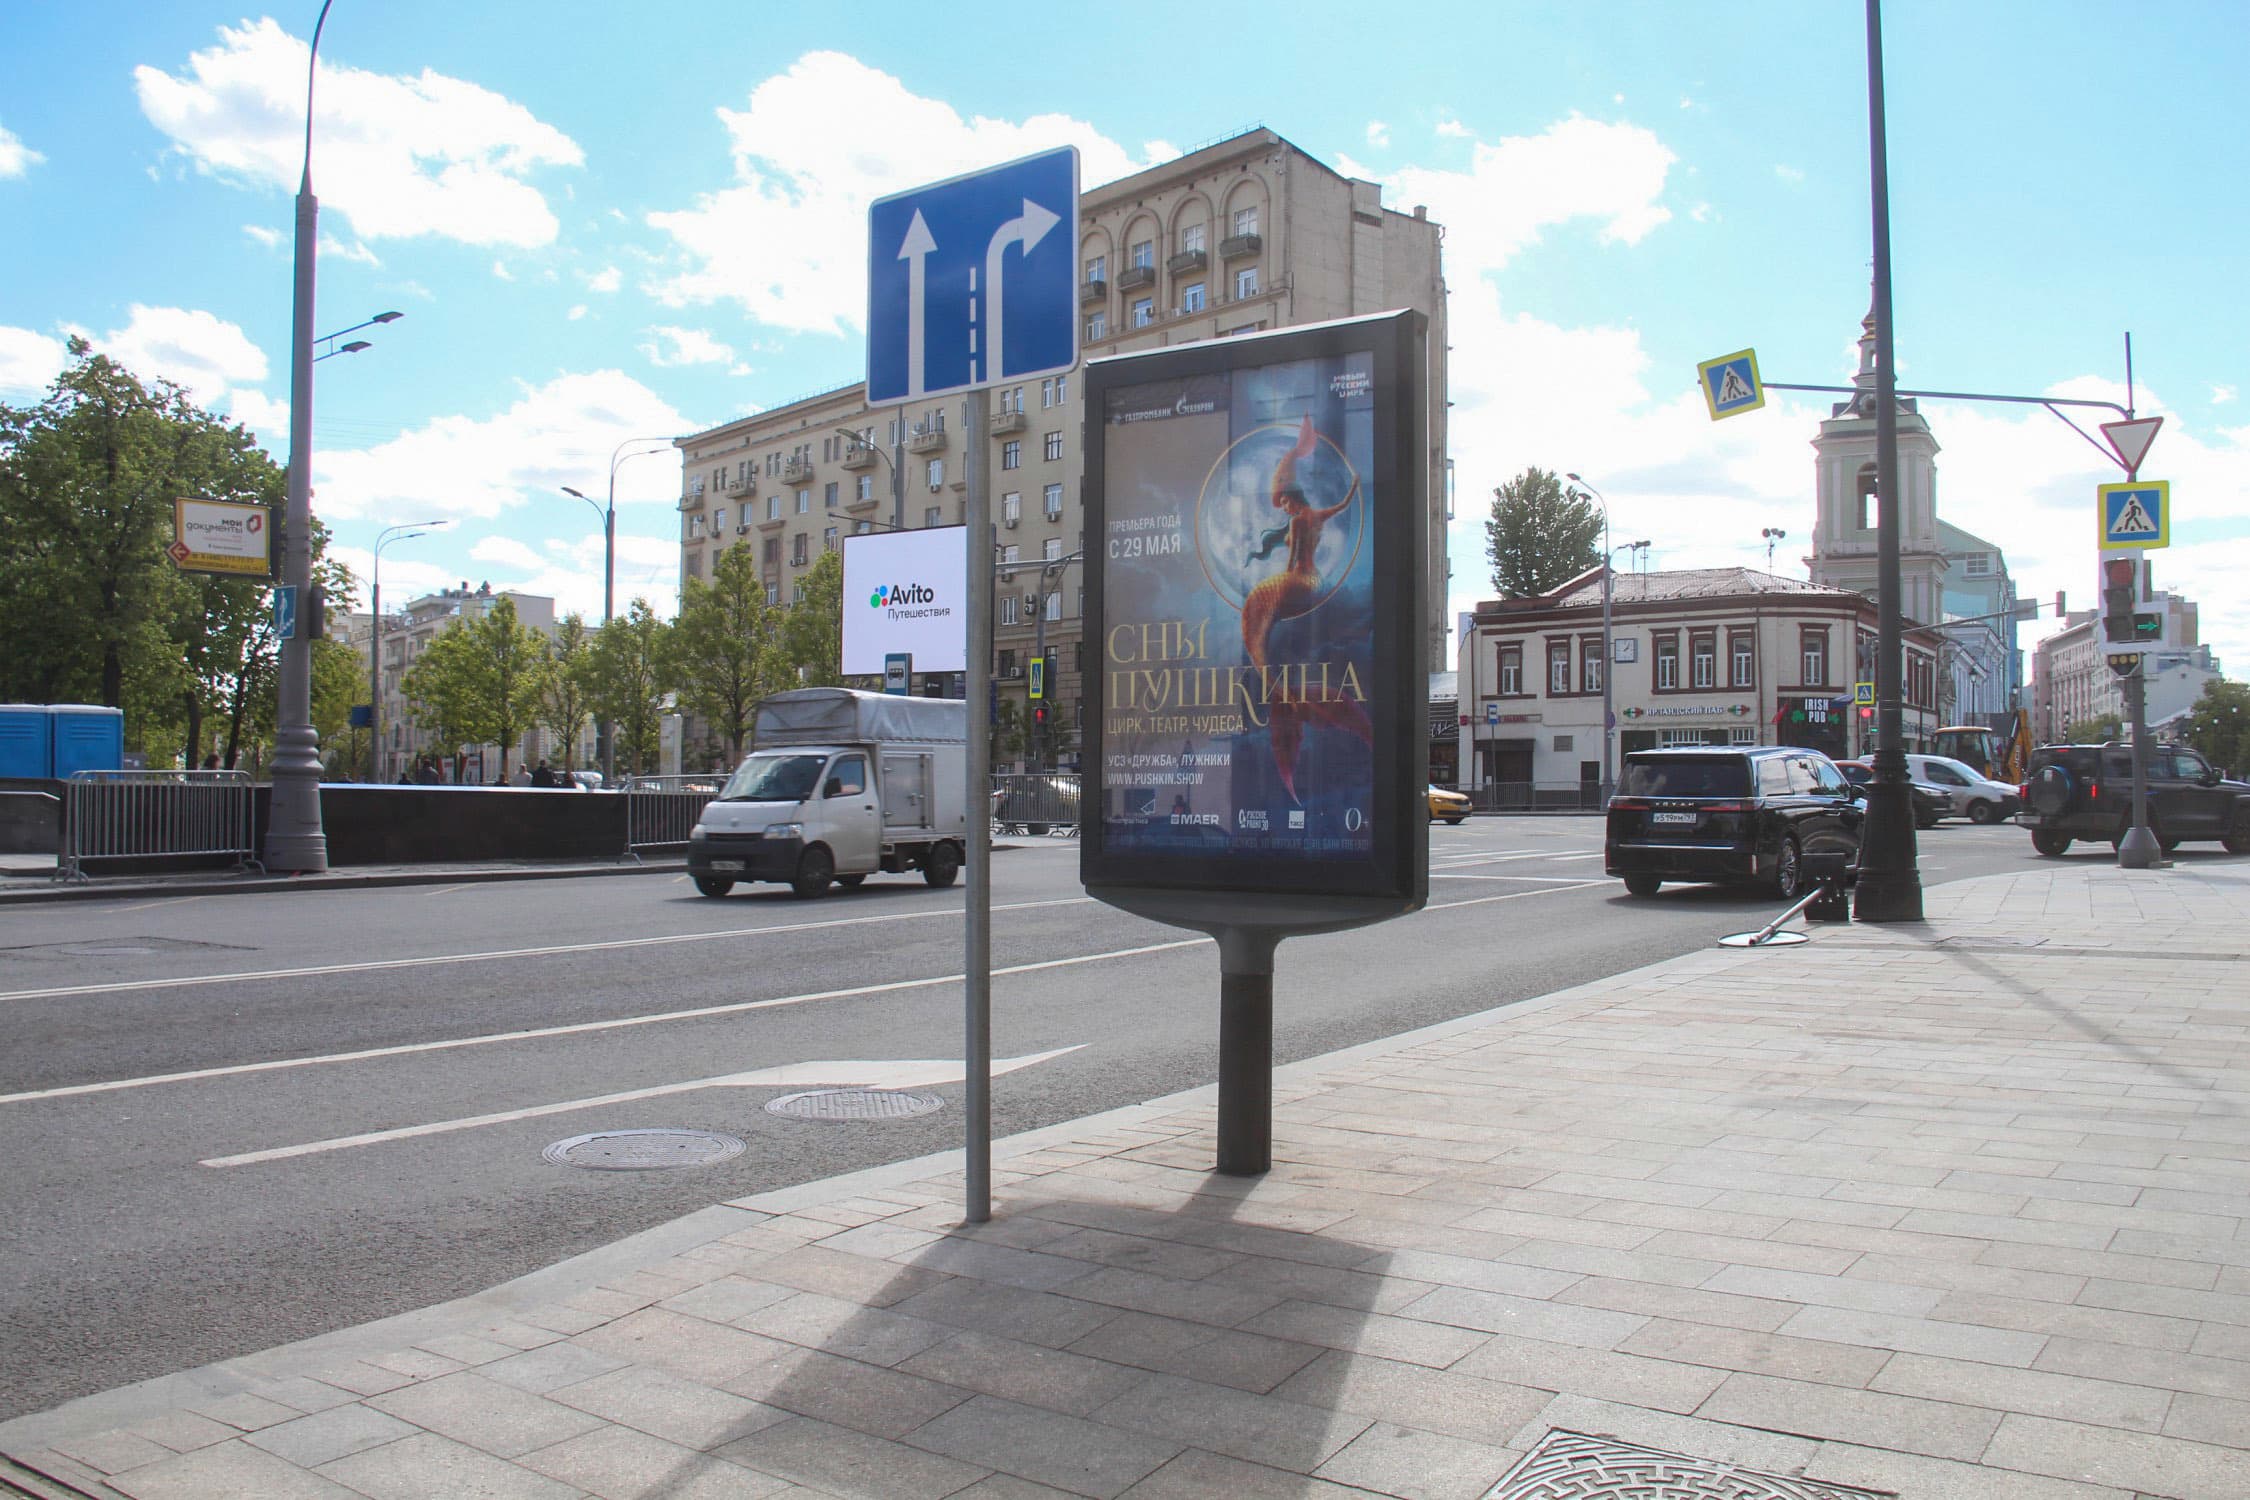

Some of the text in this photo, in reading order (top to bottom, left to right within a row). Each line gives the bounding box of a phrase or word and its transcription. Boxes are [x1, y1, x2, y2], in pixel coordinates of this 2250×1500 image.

[1109, 514, 1181, 532] ПРЕМЬЕРА ГОДА
[1123, 537, 1142, 557] 29
[1146, 534, 1180, 555] МАЯ
[889, 583, 934, 605] Avito
[888, 608, 950, 622] Путешествия
[1108, 617, 1210, 664] СНЫ
[1108, 660, 1369, 728] ПУШКИНА
[1805, 698, 1829, 710] IRISH
[1808, 711, 1826, 722] PUB
[1108, 715, 1248, 736] ЦИРК. ТЕАТР. ЧУДЕСА.
[1108, 755, 1125, 767] УСЗ
[1181, 753, 1231, 767] ЛУЖНИКИ
[1108, 773, 1204, 785] WWW.PUSHKIN.SHOW
[1181, 814, 1219, 824] MAER
